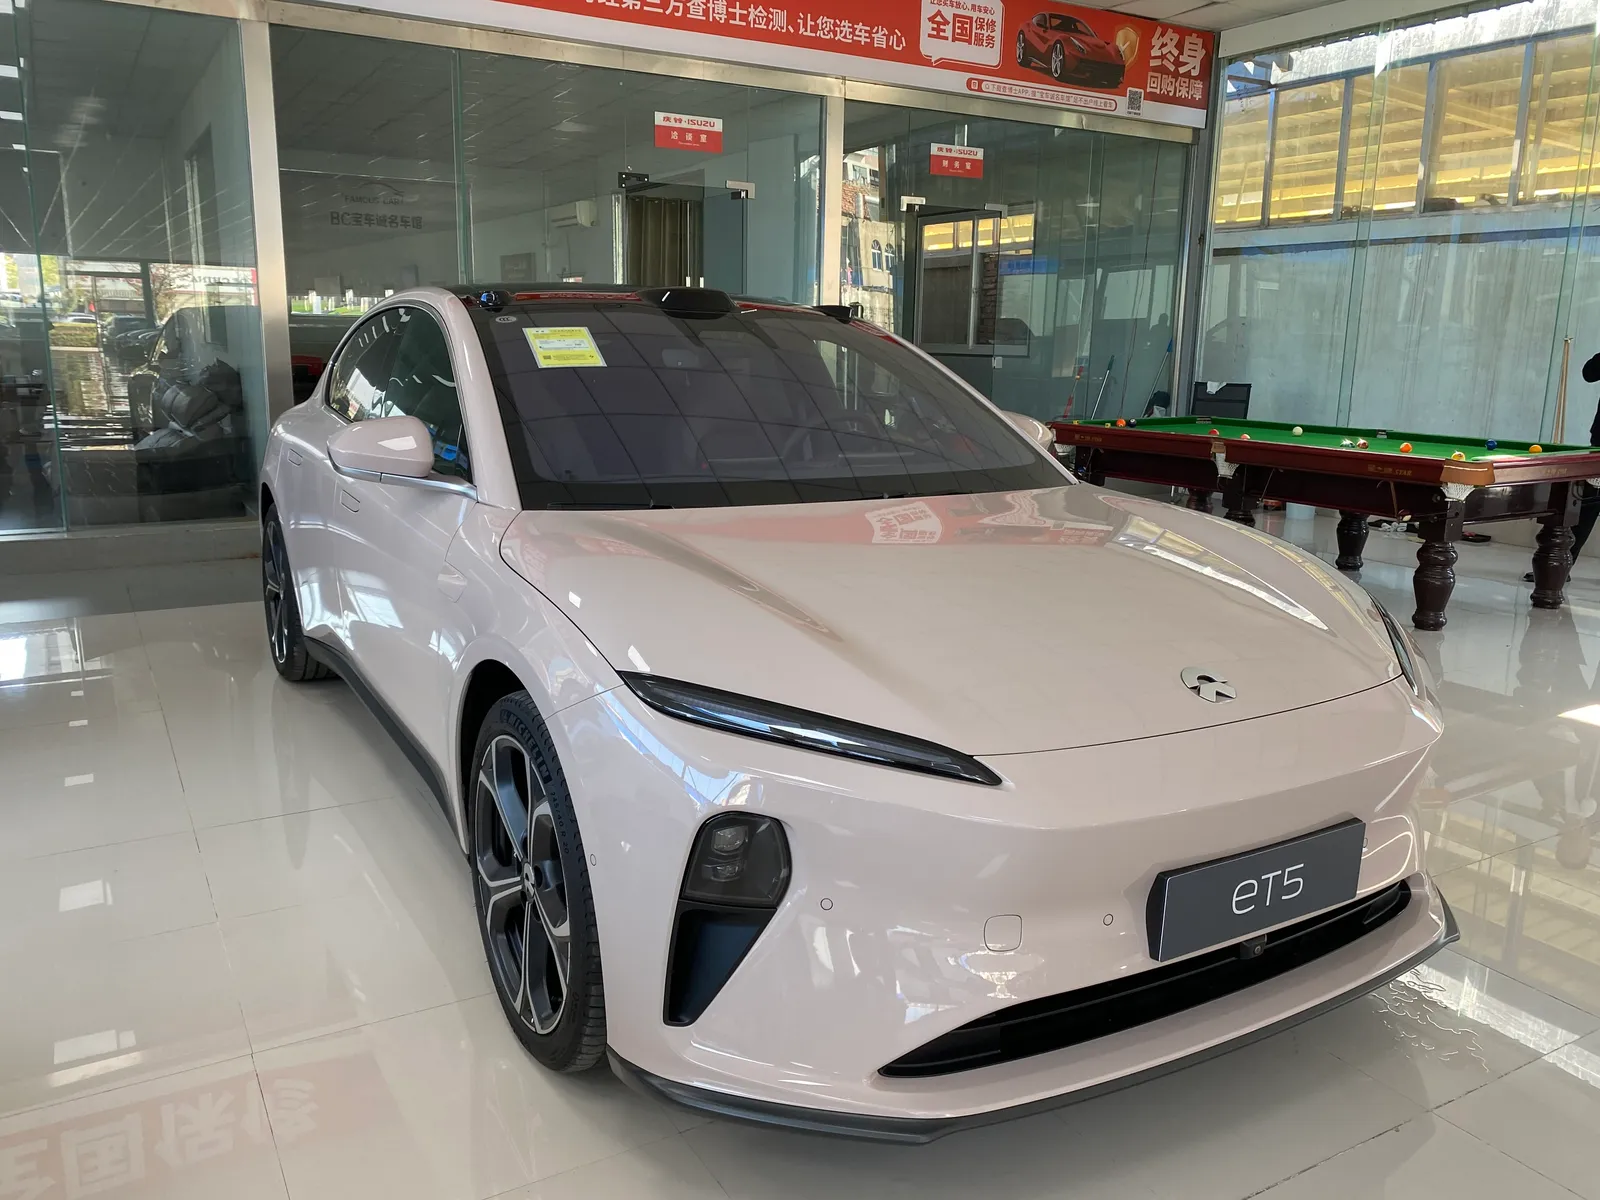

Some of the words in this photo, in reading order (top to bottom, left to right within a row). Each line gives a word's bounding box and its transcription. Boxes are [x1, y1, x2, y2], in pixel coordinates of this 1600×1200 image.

[584, 0, 906, 51] 三方查博士检测、让您选车省心
[927, 9, 974, 45] 全国
[973, 32, 996, 49] 服务
[974, 16, 997, 33] 保修
[1150, 26, 1206, 76] 终身
[1147, 72, 1203, 100] 回购保障
